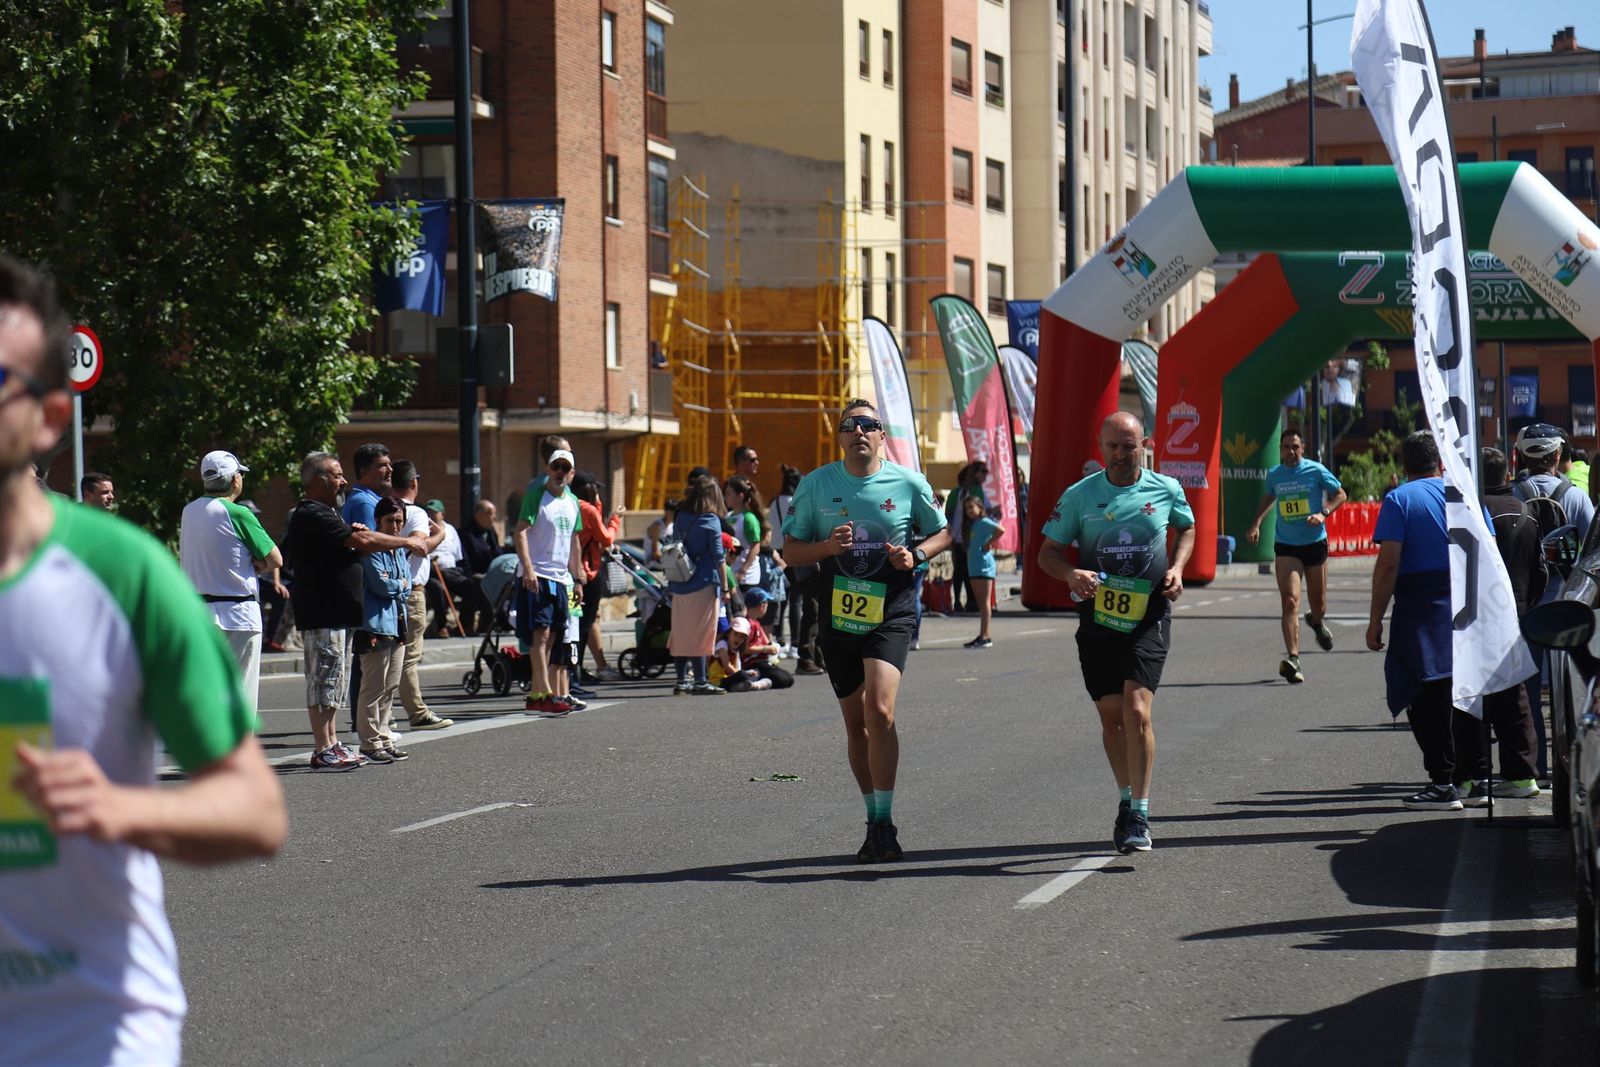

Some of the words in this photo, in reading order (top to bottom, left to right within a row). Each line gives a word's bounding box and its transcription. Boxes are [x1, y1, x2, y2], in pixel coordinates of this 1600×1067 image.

[1122, 254, 1185, 315] AYUNTAMIENTO
[1128, 304, 1146, 321] DE
[1145, 263, 1193, 306] ZAMORA
[1511, 259, 1525, 274] DE
[1528, 274, 1575, 320] ZAMORA
[1516, 254, 1581, 313] AYUNTAMIENTO
[1286, 501, 1299, 514] 81
[841, 593, 868, 618] 92
[1103, 590, 1131, 615] 88
